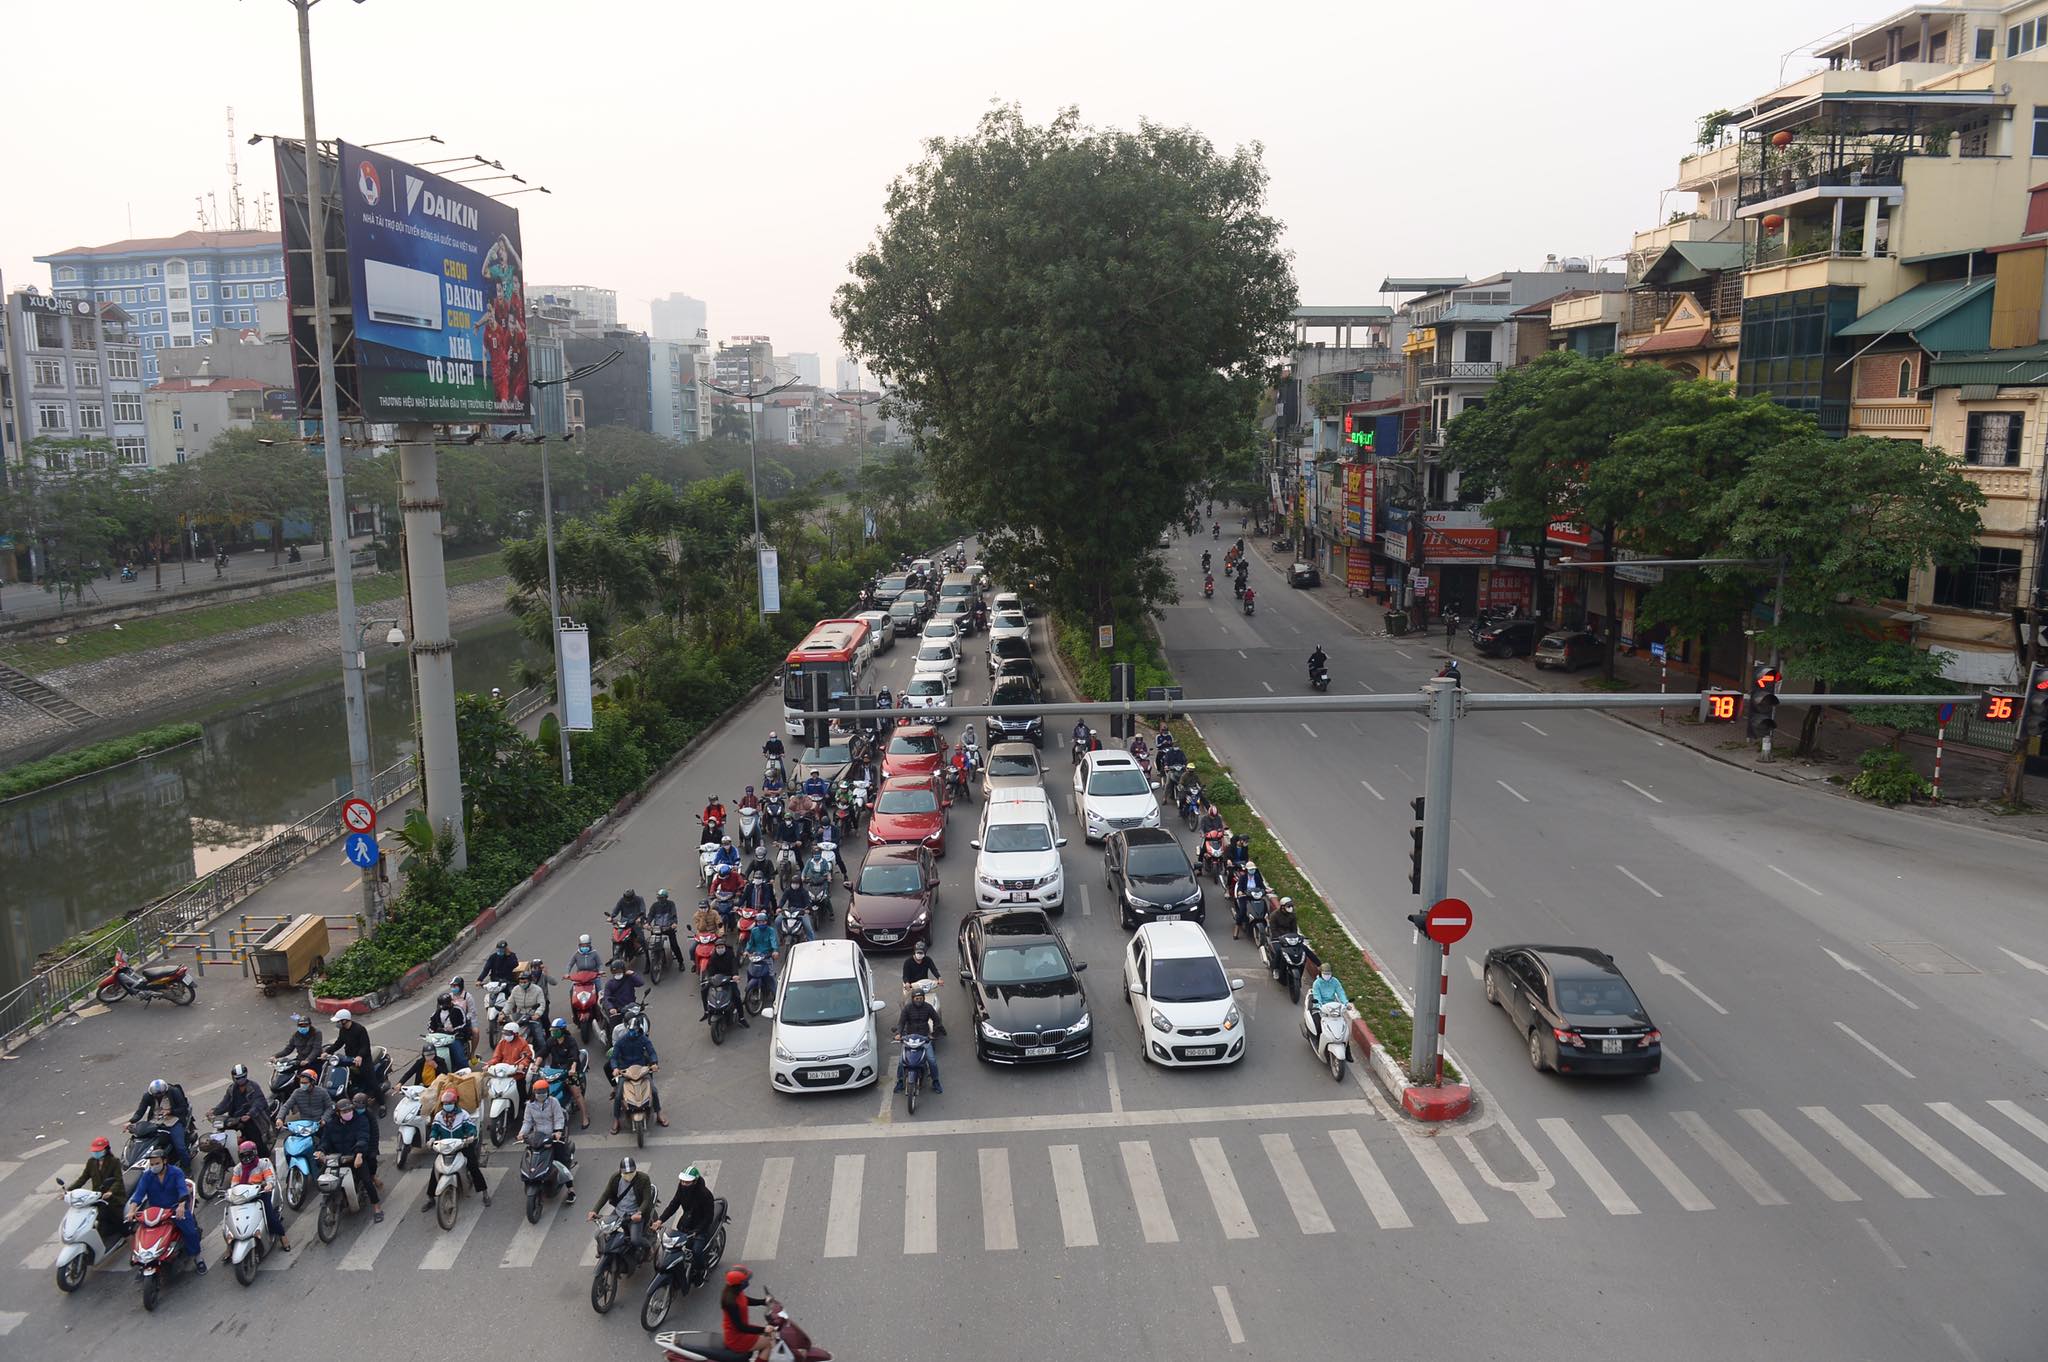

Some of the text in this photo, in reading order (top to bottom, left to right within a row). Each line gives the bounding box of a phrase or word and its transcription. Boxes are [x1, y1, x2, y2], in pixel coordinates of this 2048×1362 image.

[423, 190, 478, 231] DAIKIN
[443, 258, 468, 283] CHỌN
[445, 282, 483, 312] DAIKIN
[447, 309, 471, 334] CHỌN
[448, 333, 473, 361] NHÀ
[427, 355, 475, 390] VÔ ĐỊCH
[1709, 696, 1734, 718] 78
[1985, 697, 2013, 719] 36
